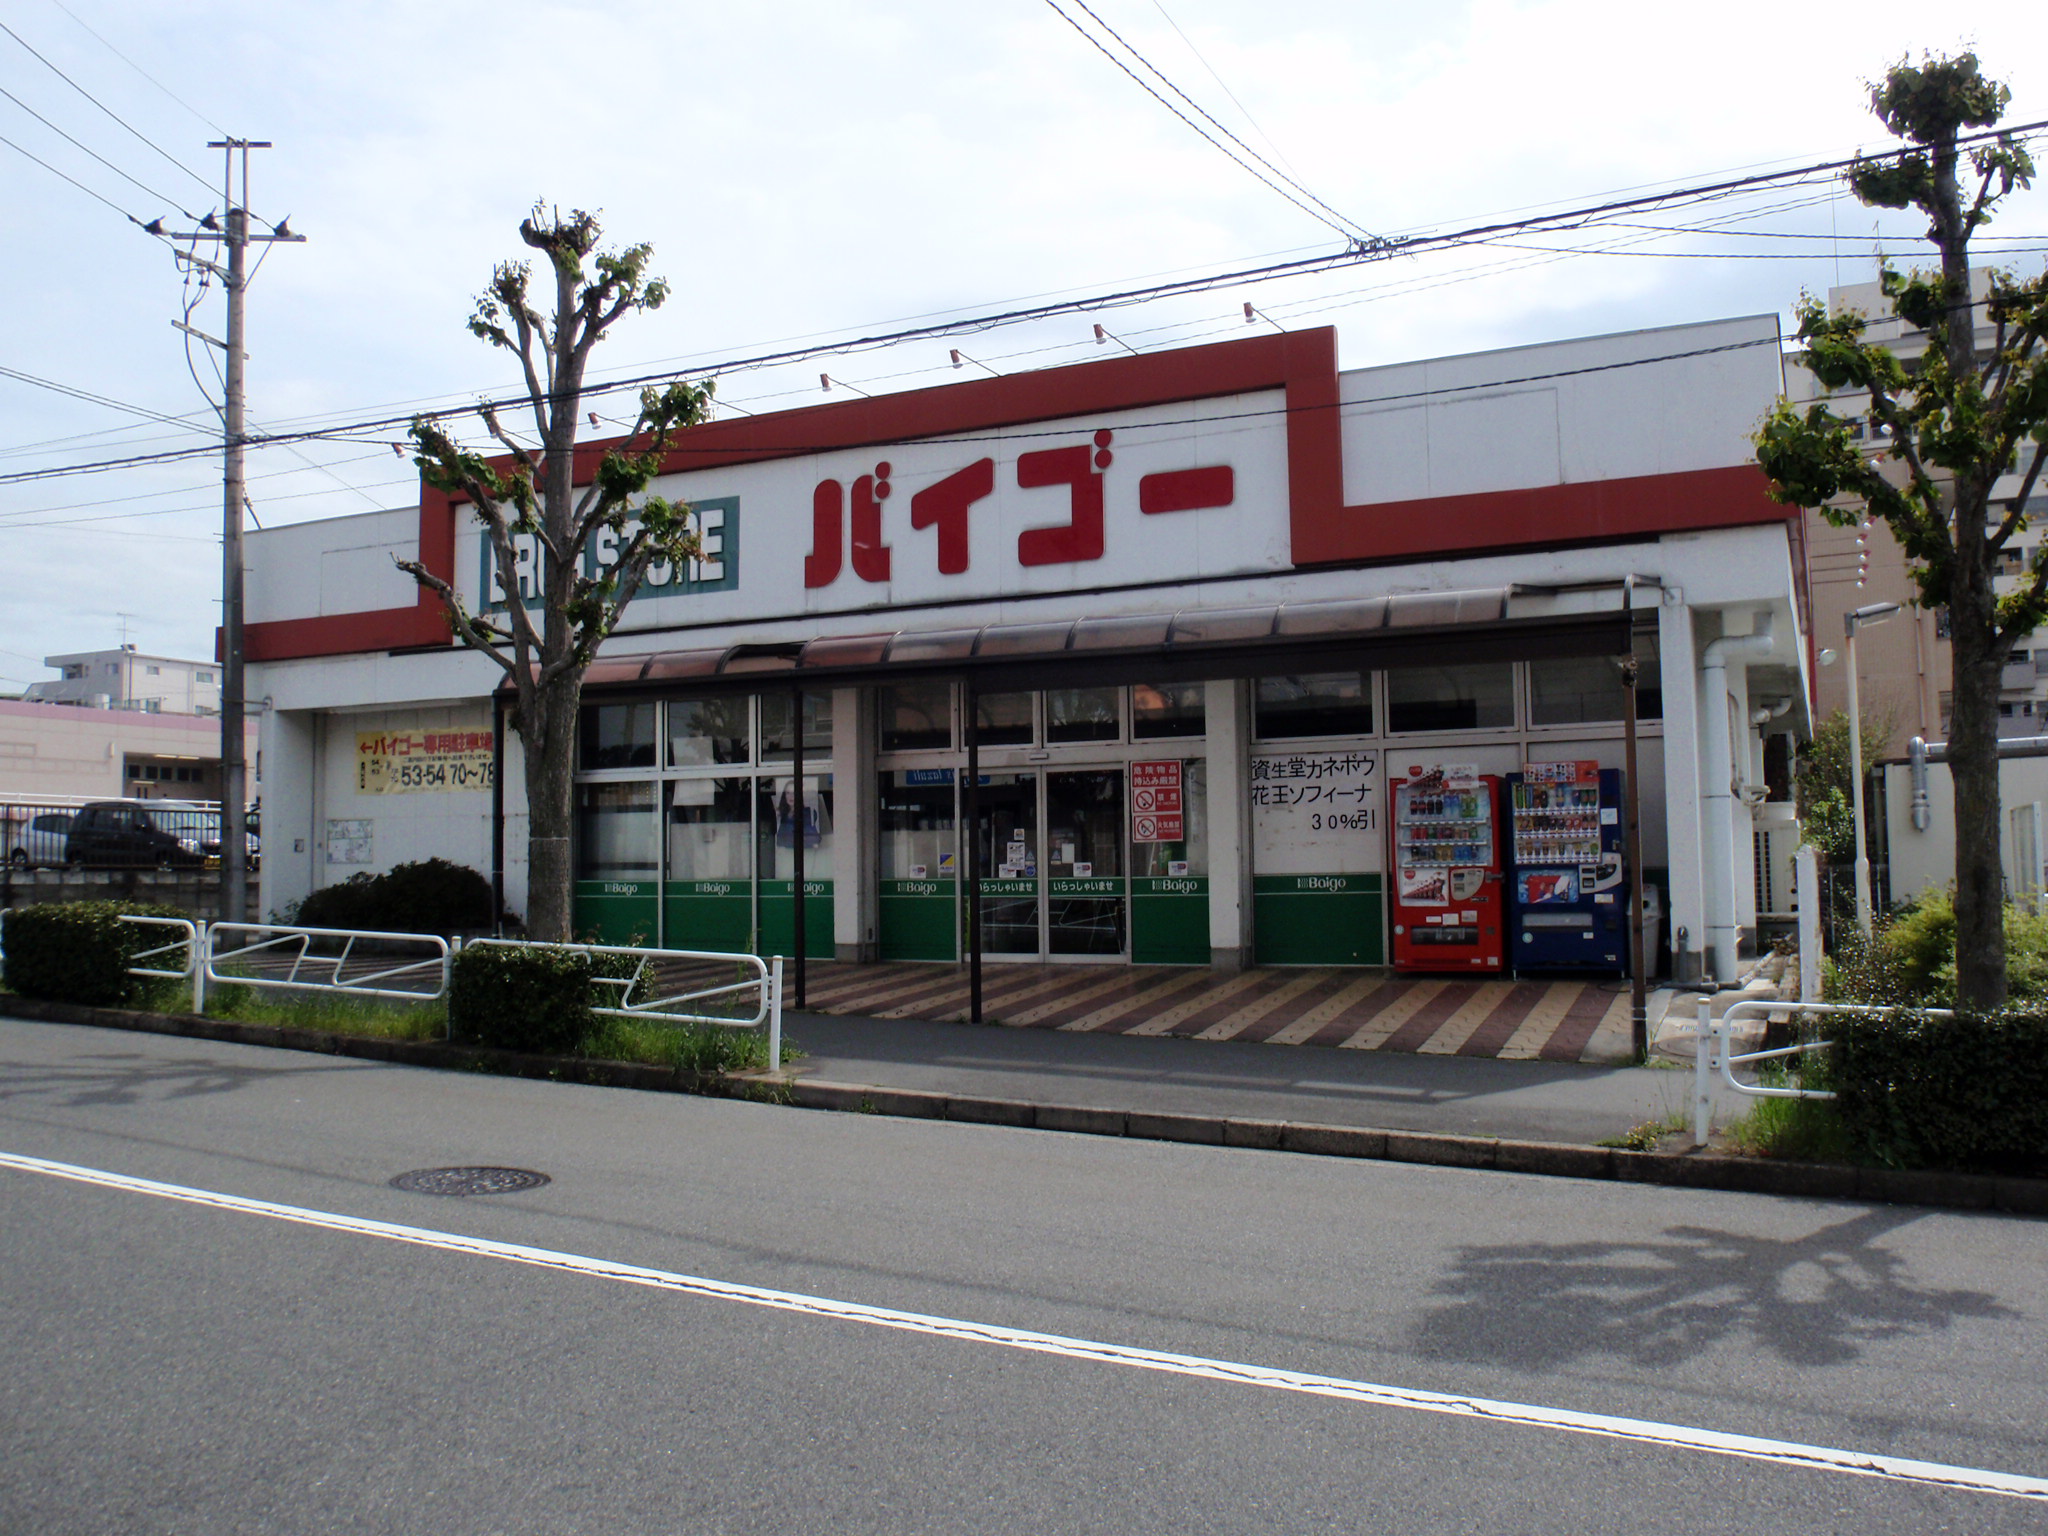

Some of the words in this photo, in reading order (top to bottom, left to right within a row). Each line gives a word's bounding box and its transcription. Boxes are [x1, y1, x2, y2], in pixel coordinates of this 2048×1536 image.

[804, 428, 1234, 588] バイゴー
[1252, 753, 1375, 781] 資生堂カネボウ
[1252, 783, 1373, 806] 花王ソフィーナ
[611, 882, 638, 896] Baigo
[702, 882, 730, 896] Baigo
[803, 882, 825, 896] aigo
[906, 881, 937, 897] Baigo
[1053, 881, 1114, 893] いらっしゃいませ
[1162, 879, 1198, 895] Baigo
[1308, 876, 1347, 892] Baigo
